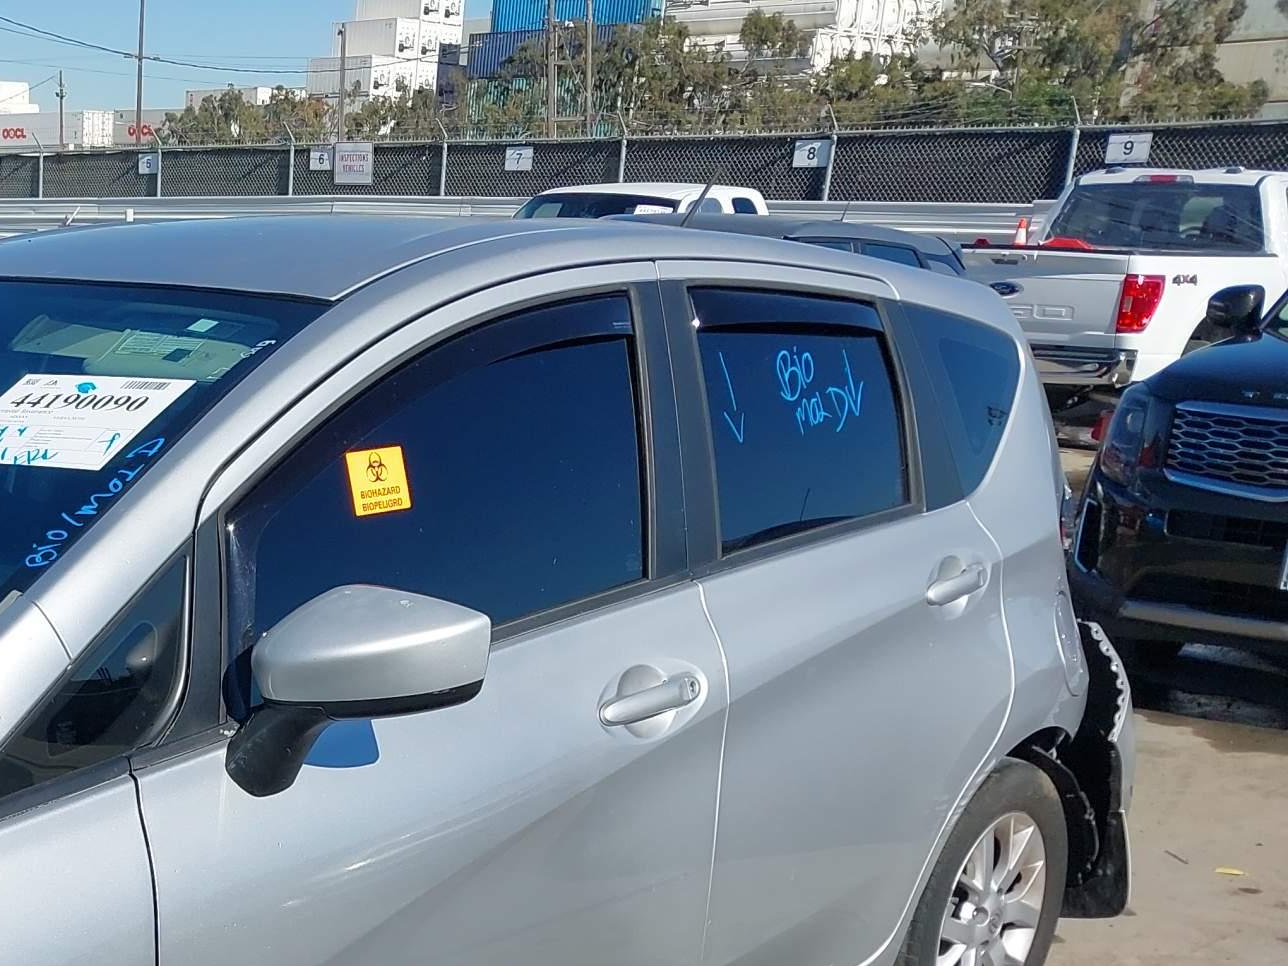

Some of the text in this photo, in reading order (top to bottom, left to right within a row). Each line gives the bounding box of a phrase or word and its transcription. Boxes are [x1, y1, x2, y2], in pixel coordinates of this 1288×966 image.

[2, 127, 27, 140] OOCL
[806, 146, 817, 161] 8
[1122, 140, 1135, 156] 9
[318, 153, 325, 165] 6
[516, 153, 523, 165] 7
[10, 392, 150, 412] 44190090
[360, 485, 401, 499] BIOHAZARD
